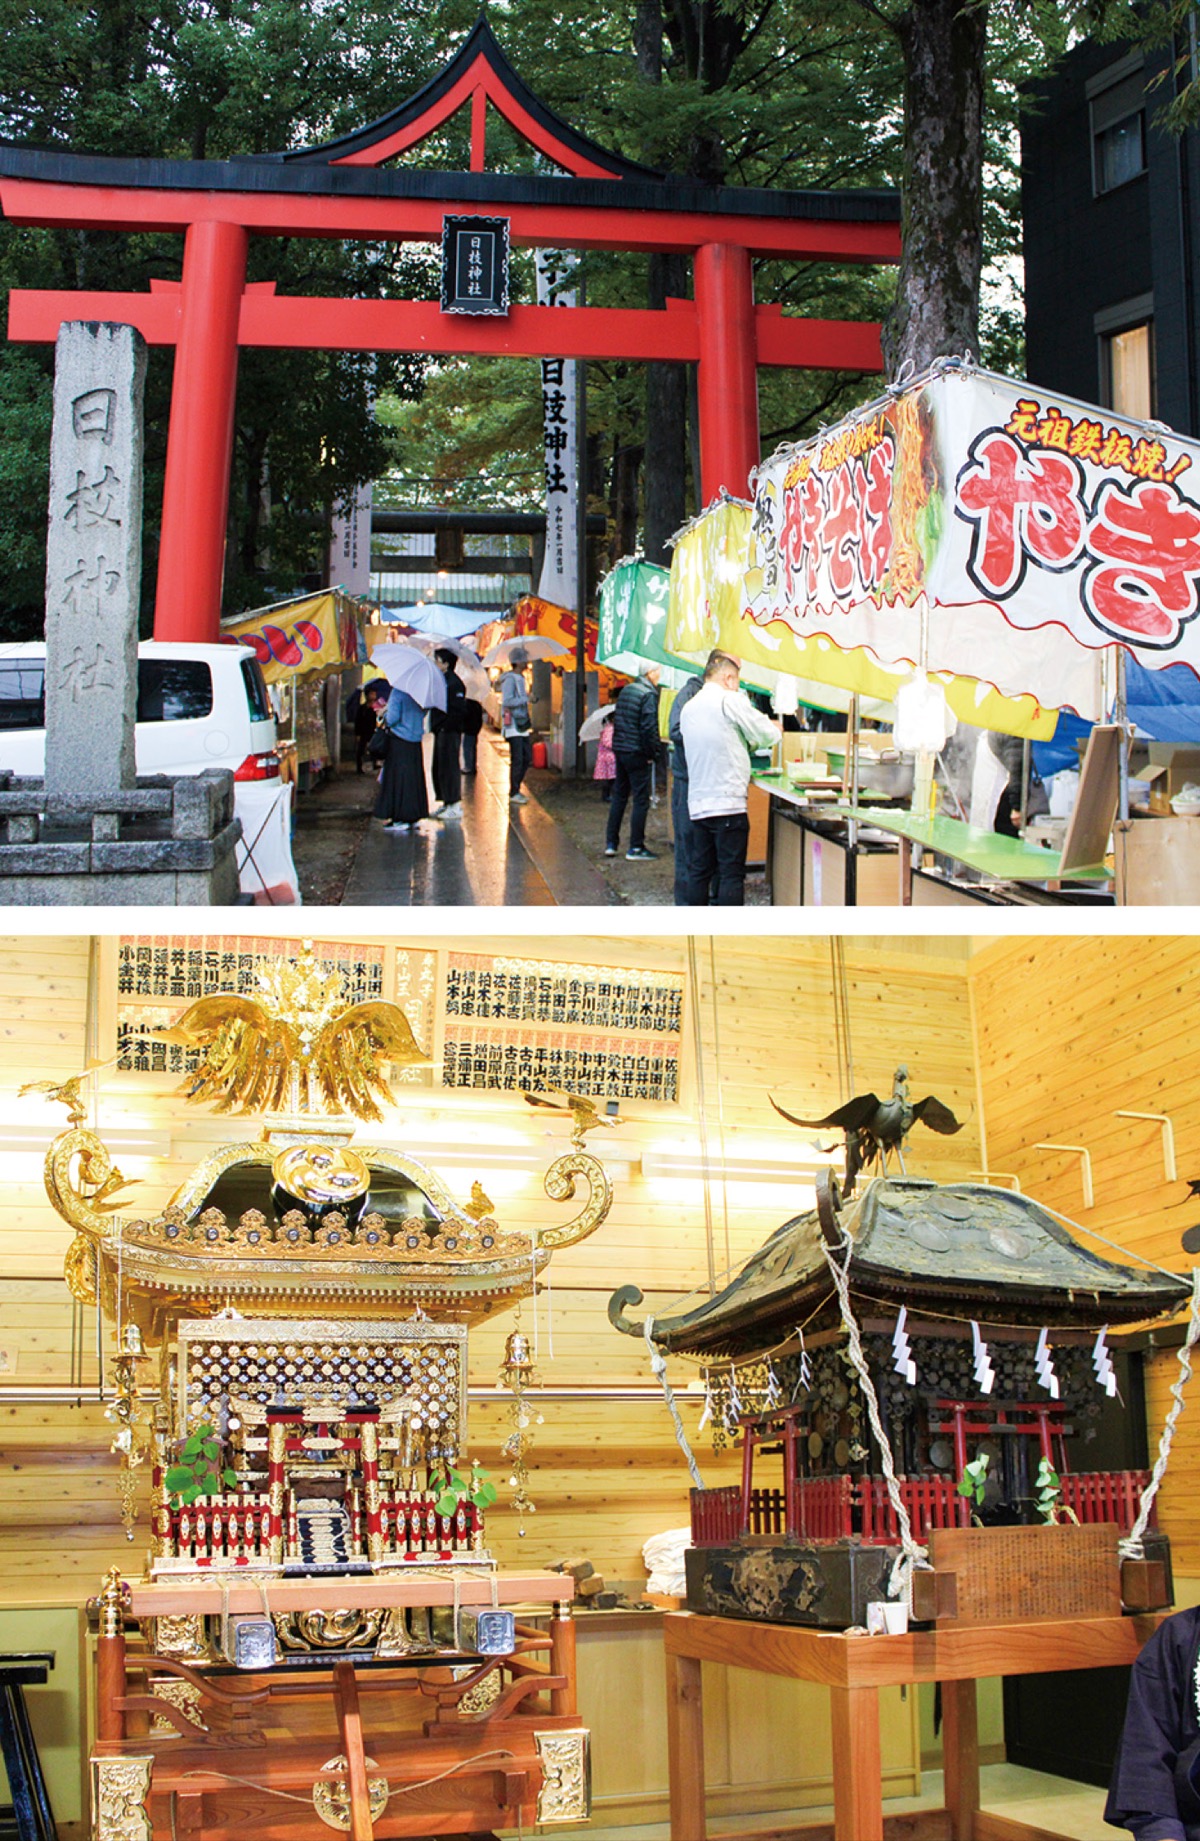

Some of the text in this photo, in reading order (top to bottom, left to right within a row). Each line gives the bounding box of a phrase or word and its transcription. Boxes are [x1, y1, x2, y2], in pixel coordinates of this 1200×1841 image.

[467, 236, 483, 297] 日枝神社
[58, 387, 122, 704] 日枝神社
